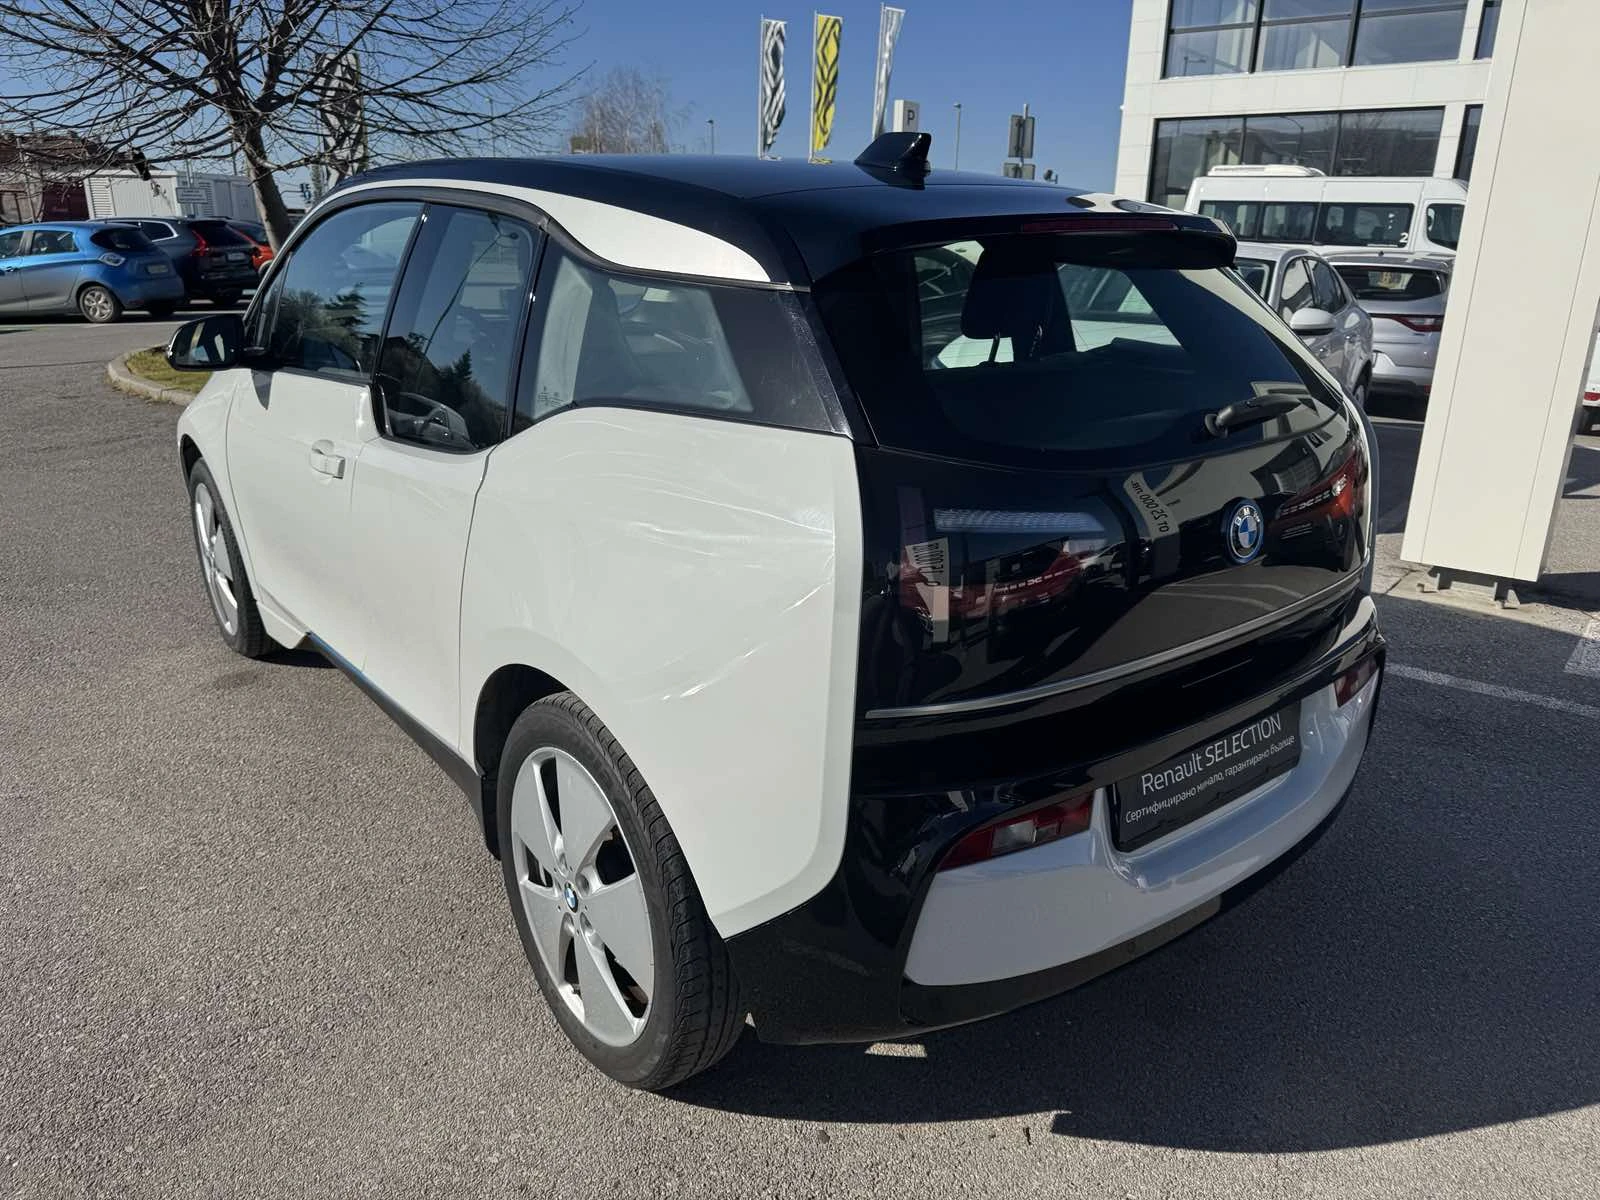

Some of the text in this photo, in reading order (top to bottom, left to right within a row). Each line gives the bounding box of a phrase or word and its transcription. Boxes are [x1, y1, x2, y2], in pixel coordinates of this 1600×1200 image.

[906, 109, 916, 126] P
[1399, 232, 1409, 243] 2
[1234, 506, 1261, 526] BMW
[1141, 712, 1282, 795] Renault SELECTION
[1125, 784, 1197, 823] Сертифицирано
[1225, 749, 1270, 778] гарантирано
